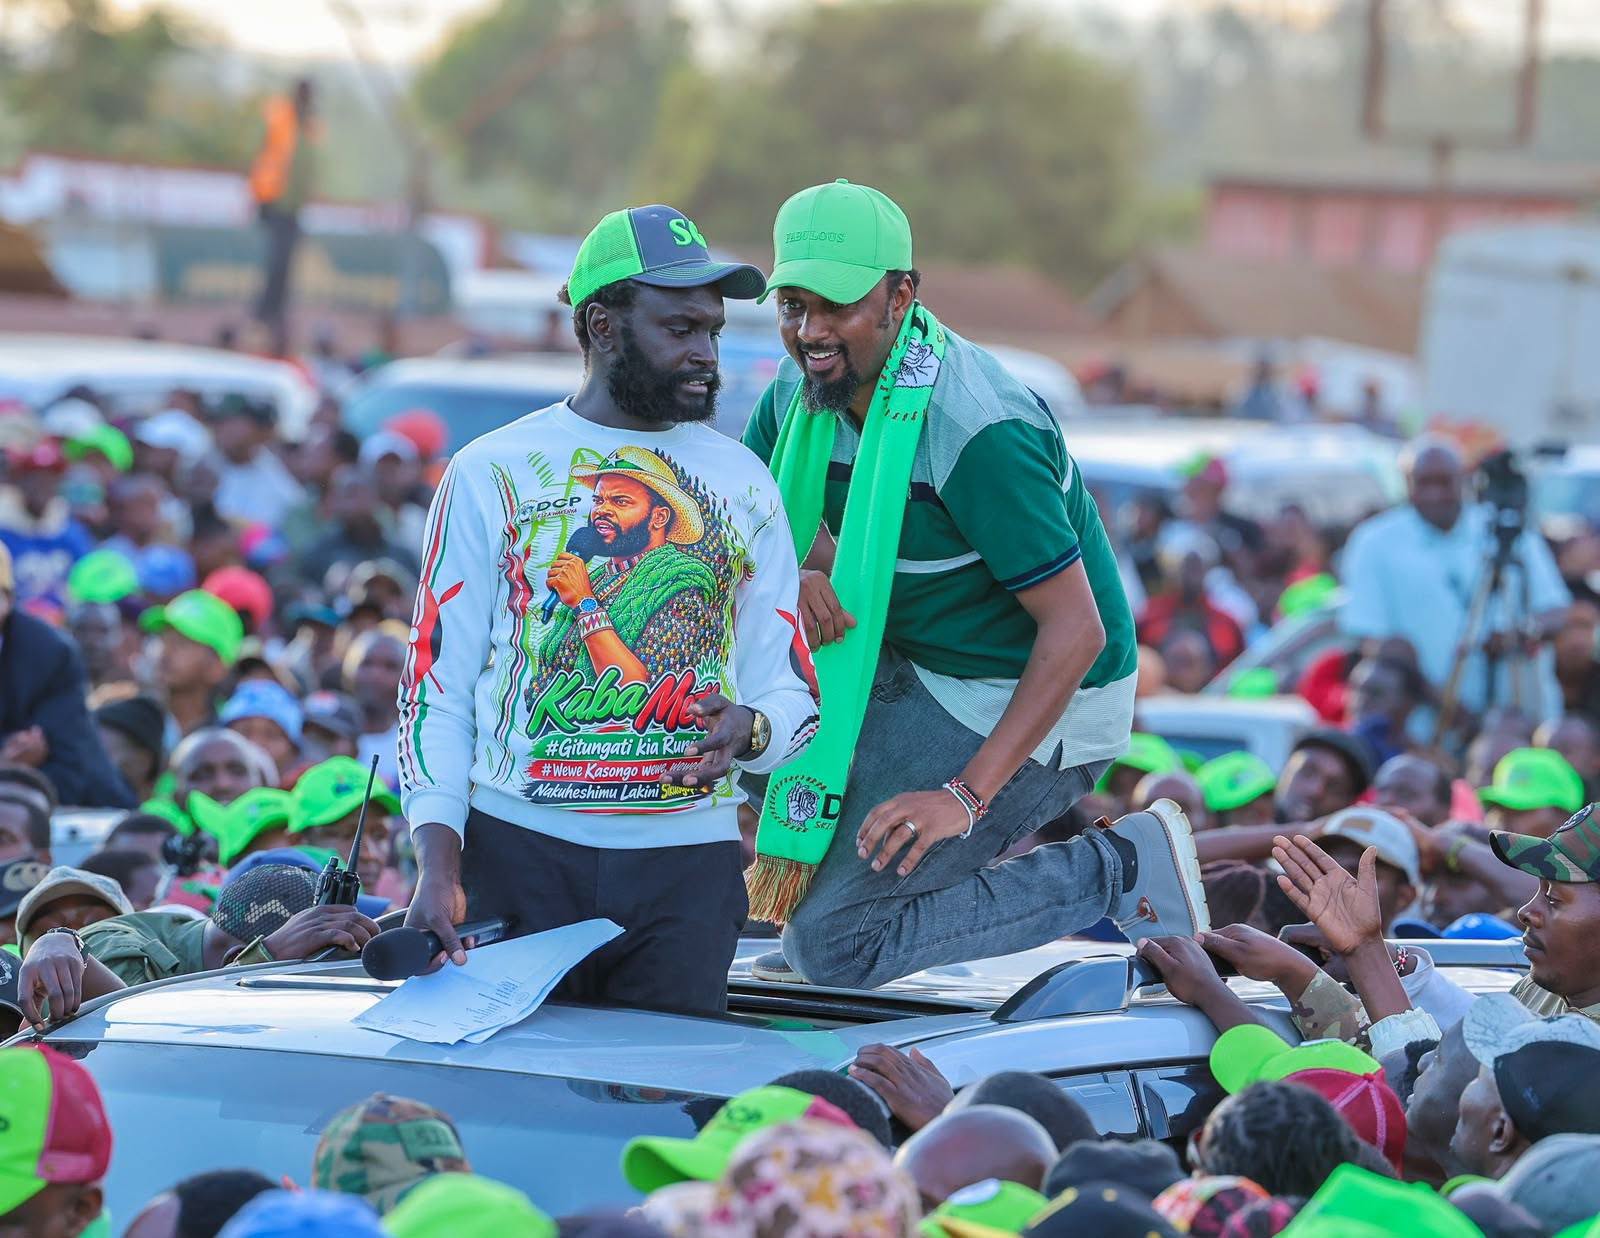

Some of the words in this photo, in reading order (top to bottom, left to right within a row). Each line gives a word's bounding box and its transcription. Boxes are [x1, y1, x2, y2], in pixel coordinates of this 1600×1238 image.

[785, 230, 847, 244] FABULOUS
[536, 496, 582, 512] DCP
[545, 737, 634, 760] #Gitungati
[635, 738, 659, 756] kia
[584, 762, 639, 781] Kasongo
[531, 782, 618, 799] Nakuheshimu
[620, 783, 660, 801] Lakini
